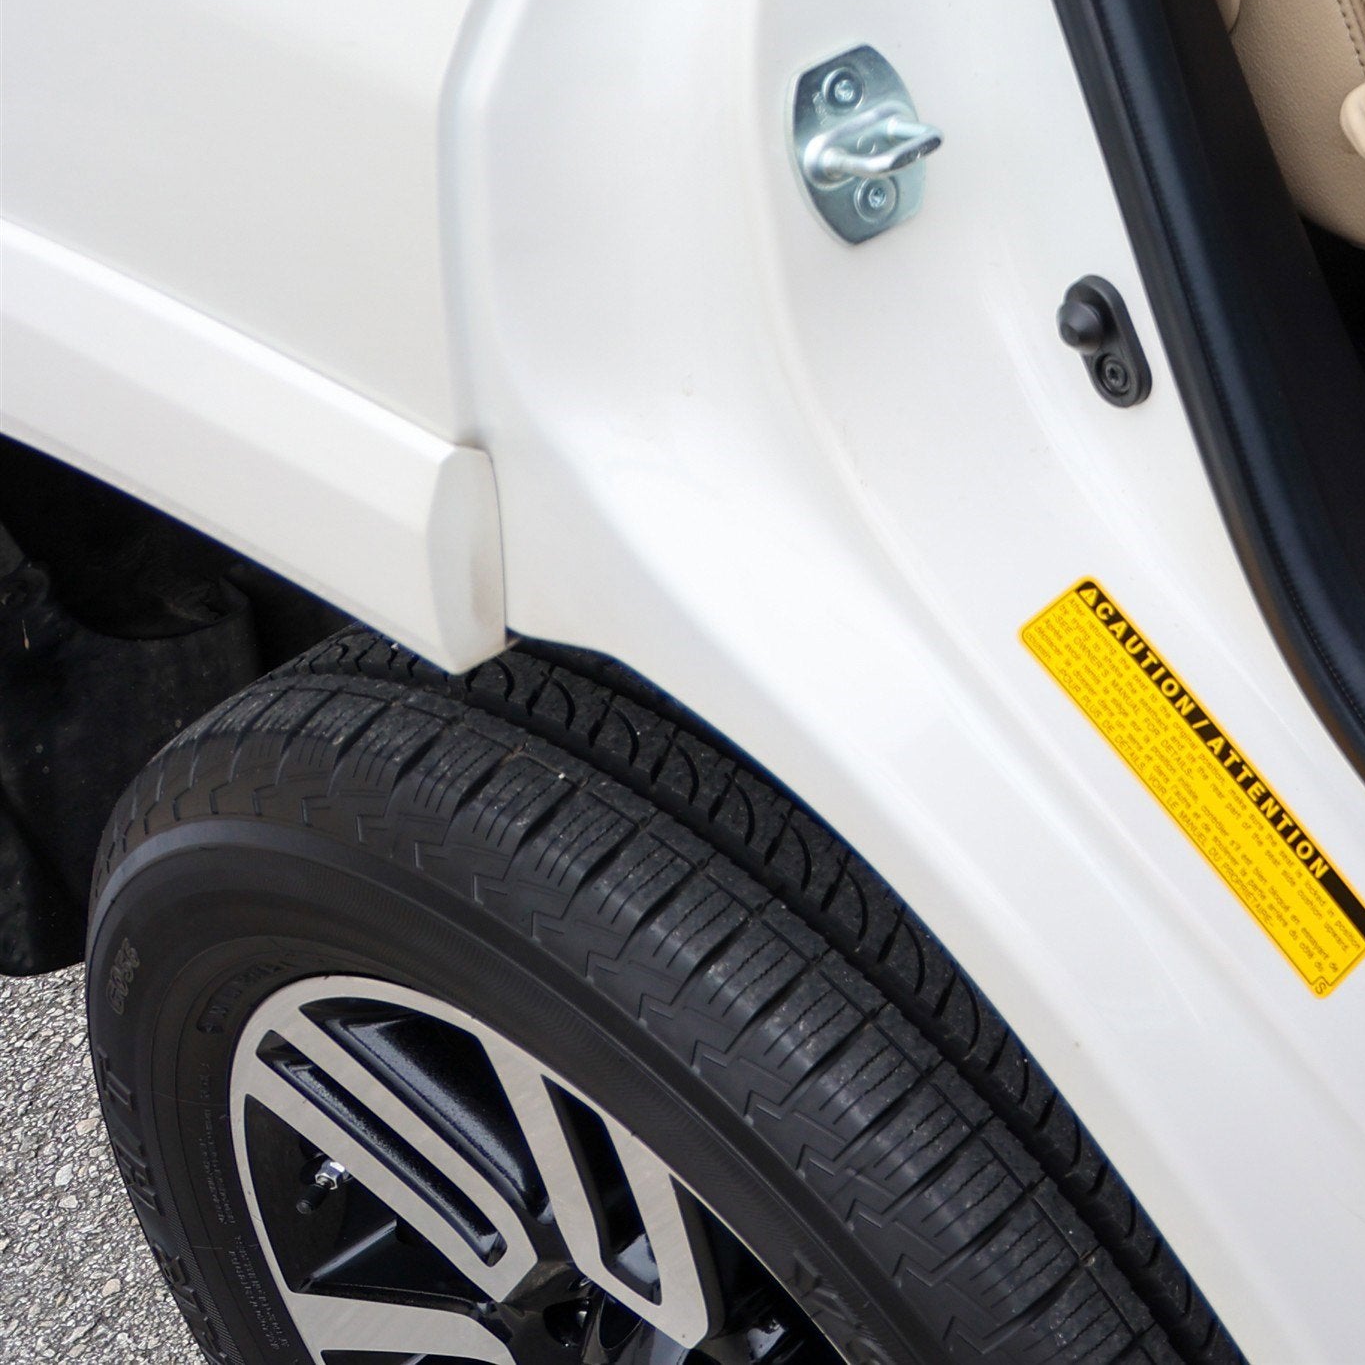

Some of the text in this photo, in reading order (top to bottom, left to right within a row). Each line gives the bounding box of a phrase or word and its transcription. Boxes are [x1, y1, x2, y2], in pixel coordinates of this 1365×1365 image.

[1108, 677, 1143, 716] MANUAL
[1092, 598, 1196, 718] CAUTION
[1204, 731, 1331, 880] ATTENTION
[1312, 979, 1328, 997] S
